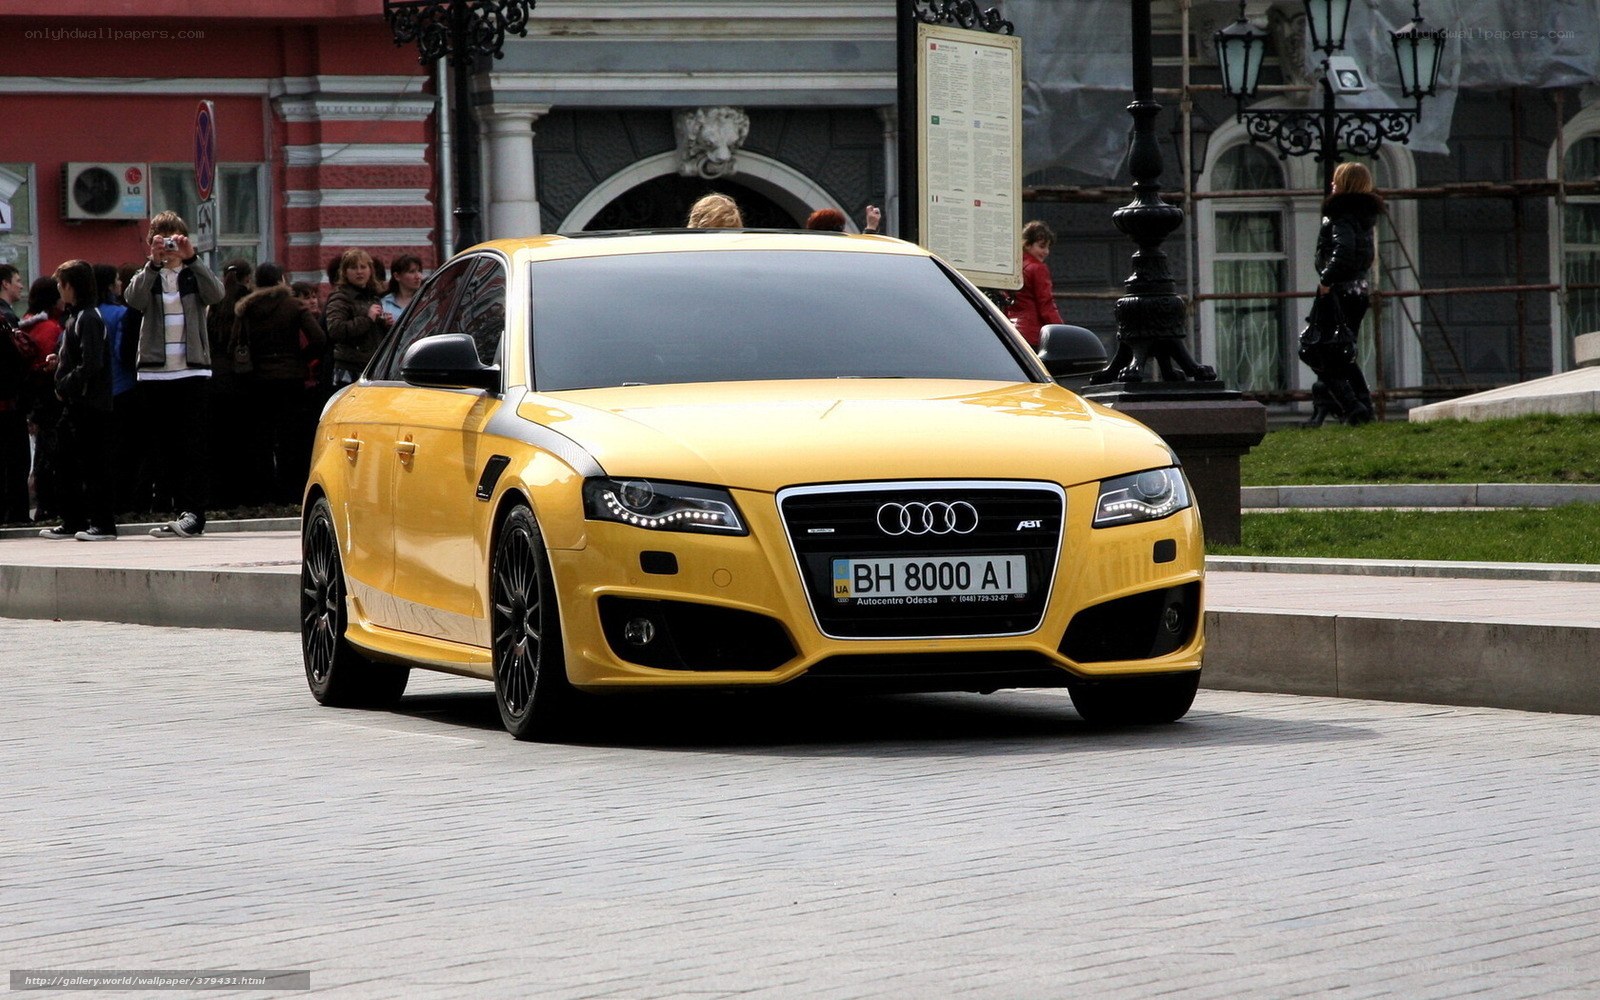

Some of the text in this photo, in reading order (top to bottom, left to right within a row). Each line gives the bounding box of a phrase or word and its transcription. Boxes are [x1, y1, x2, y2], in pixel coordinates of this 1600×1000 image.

[127, 186, 140, 195] LG
[1016, 519, 1043, 531] ABT
[853, 560, 1012, 593] BH 8000 AI
[836, 585, 849, 594] UA
[857, 597, 903, 606] Autocentre
[906, 596, 938, 604] Odessa
